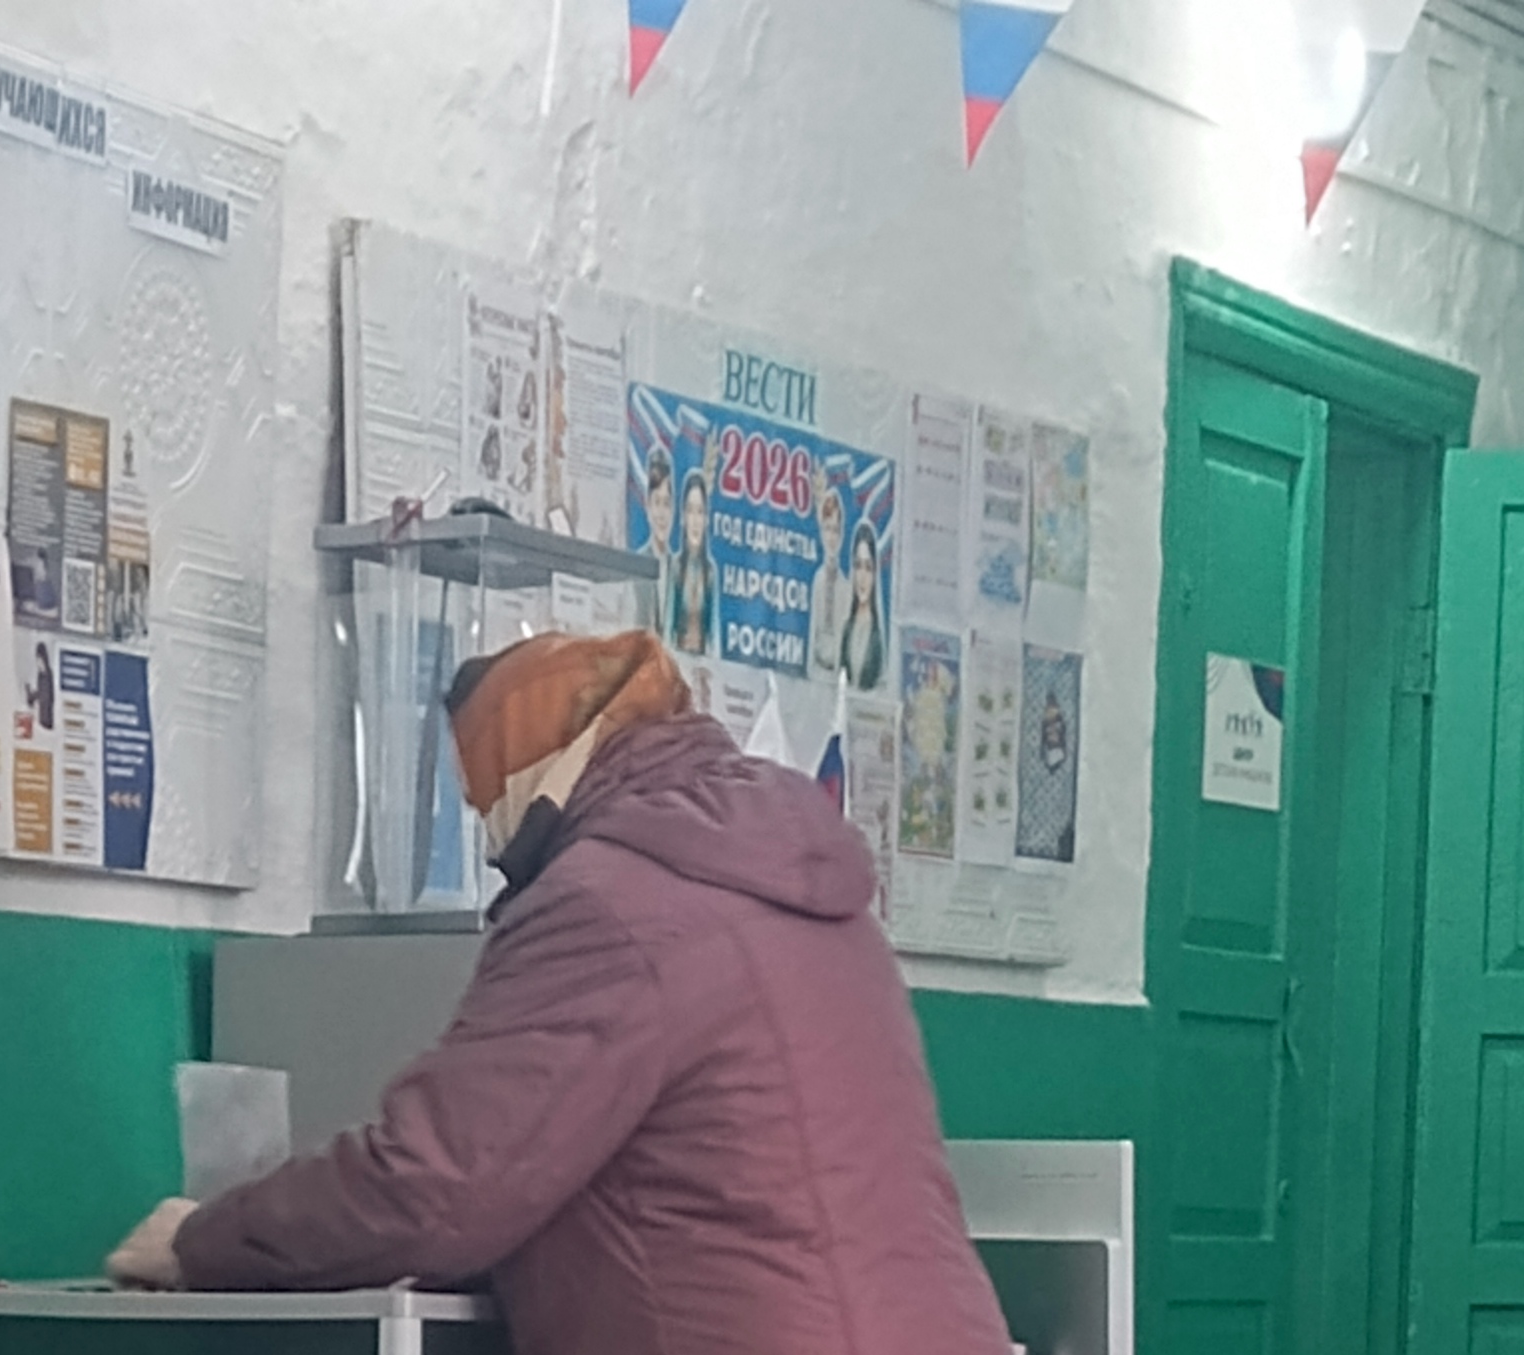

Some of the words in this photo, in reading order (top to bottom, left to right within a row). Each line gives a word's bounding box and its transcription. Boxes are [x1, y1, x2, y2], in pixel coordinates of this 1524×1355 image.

[131, 169, 229, 244] ИНФОРМАЦИЯ
[725, 349, 817, 426] ВЕСТИ
[720, 426, 812, 517] 2026
[713, 512, 743, 547] ГОД
[745, 520, 818, 562] ЕДИНСТВА
[722, 564, 809, 614] НАРОДОВ
[727, 622, 805, 666] РОССИИ
